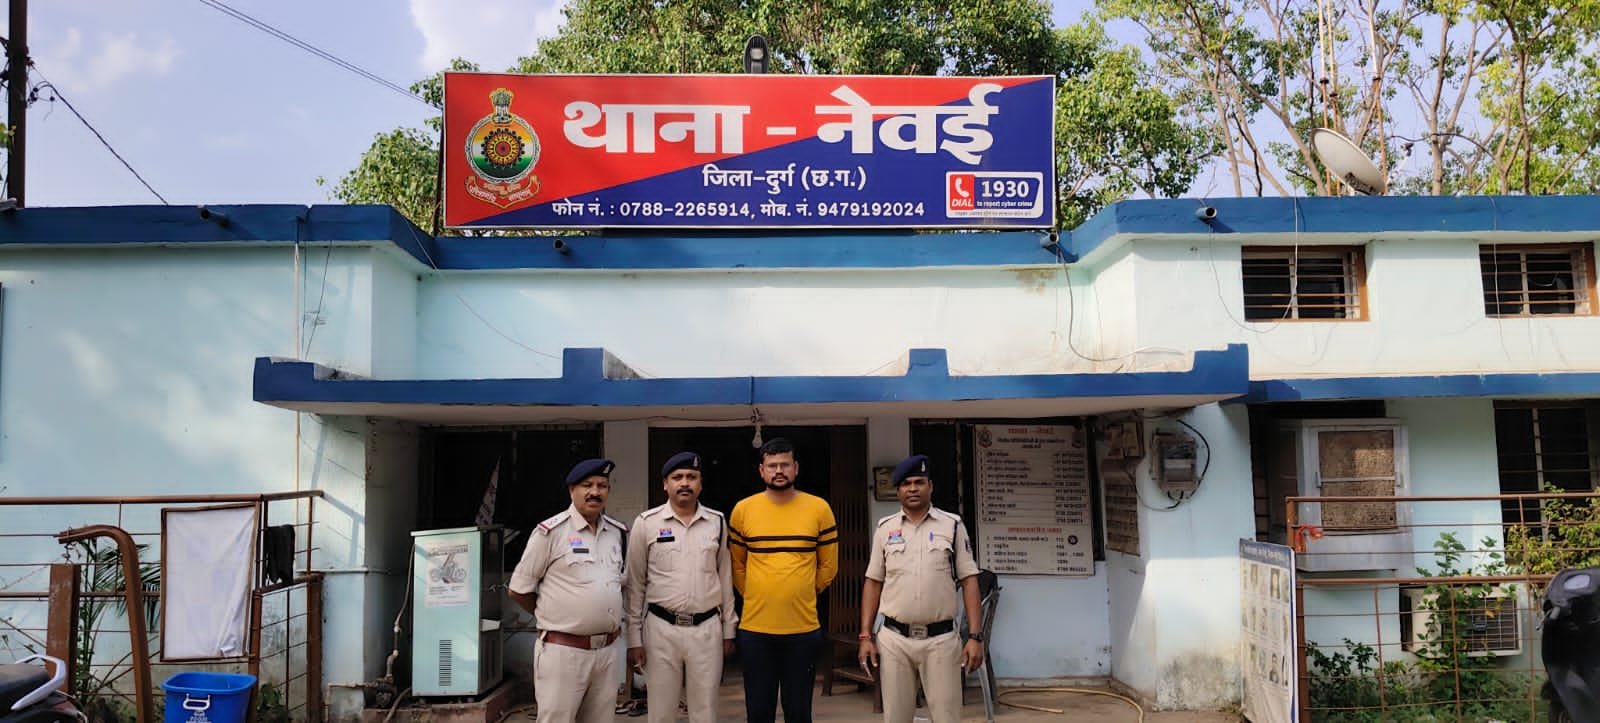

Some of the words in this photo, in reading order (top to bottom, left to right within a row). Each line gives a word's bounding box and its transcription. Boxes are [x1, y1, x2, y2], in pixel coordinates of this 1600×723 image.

[563, 101, 751, 155] थाना
[815, 82, 1004, 166] नेवई
[701, 162, 796, 195] जिला-दुर्ग
[801, 165, 867, 191] (छ.ग.)
[981, 180, 1030, 198] 1930
[551, 197, 585, 217] फोन
[587, 197, 605, 217] नं.
[619, 202, 756, 220] 0788-2265914,
[759, 198, 792, 218] मोब.
[795, 197, 812, 217] नं.
[817, 202, 925, 217] 9479192024
[952, 198, 974, 207] DIAL
